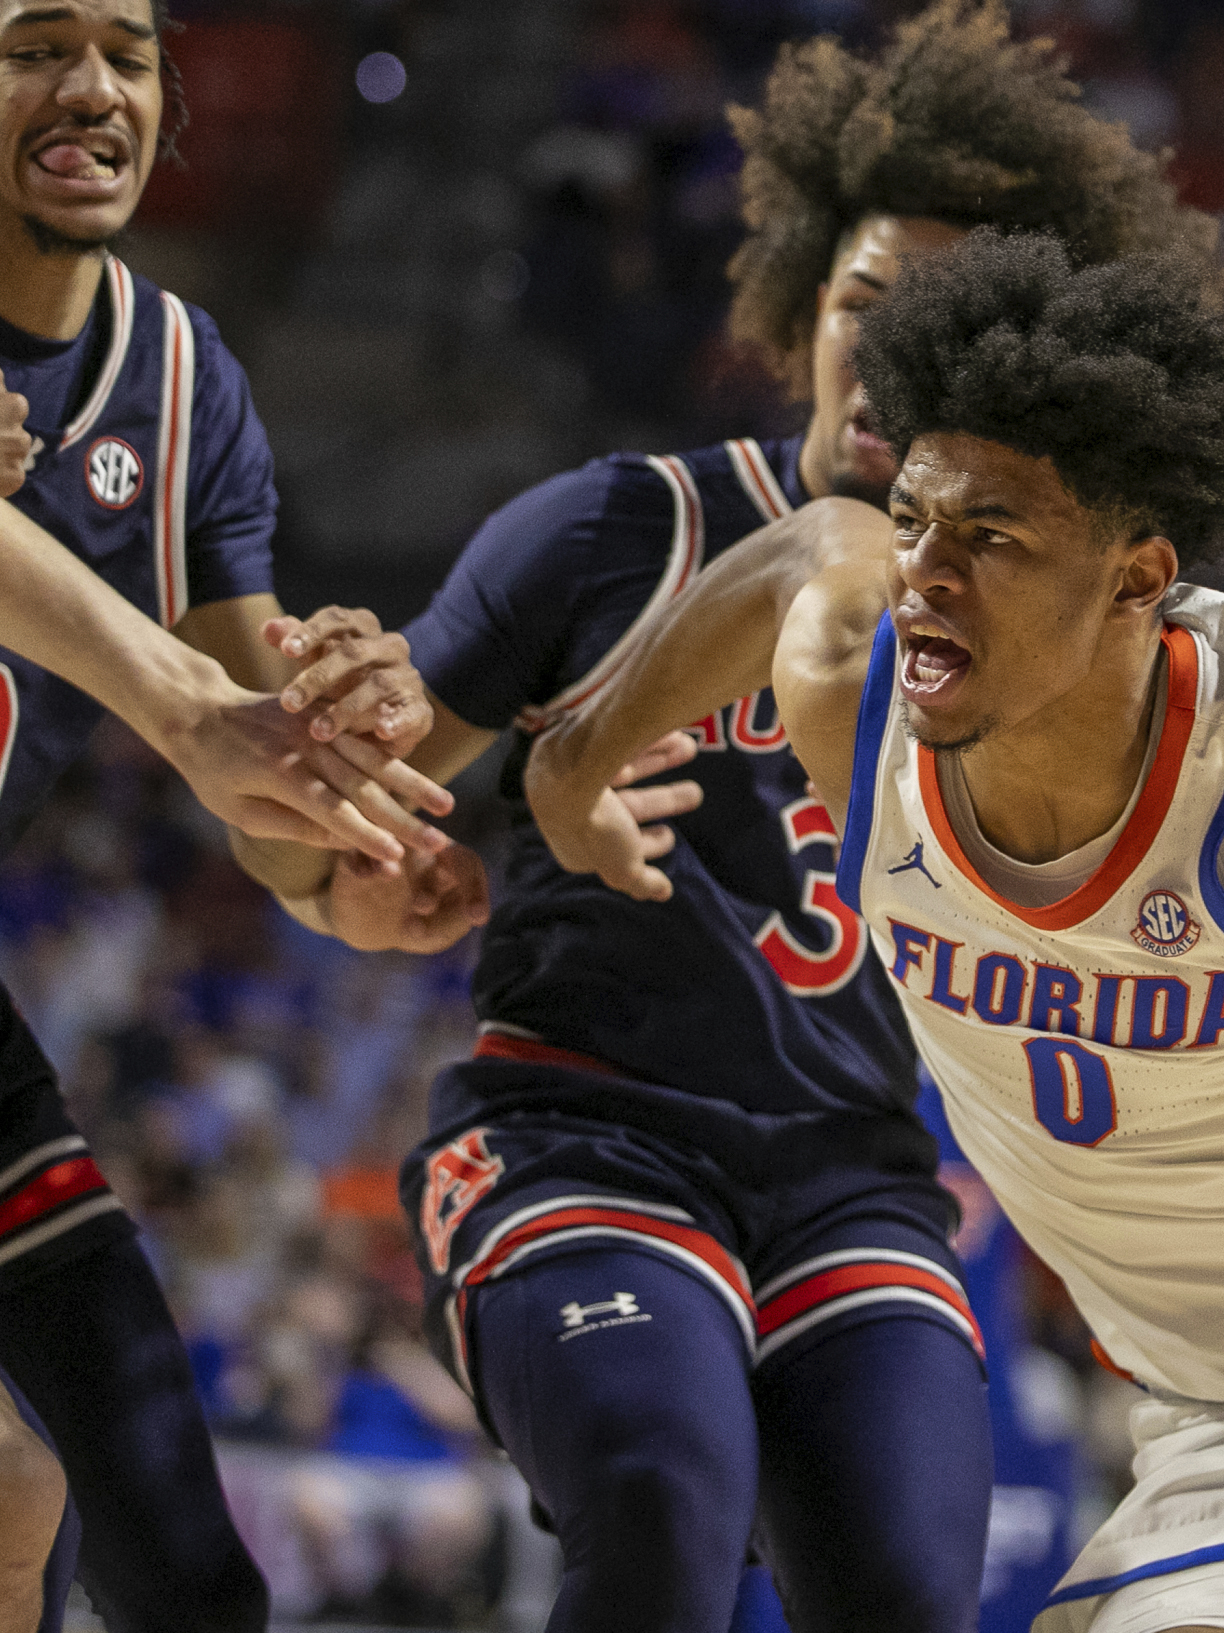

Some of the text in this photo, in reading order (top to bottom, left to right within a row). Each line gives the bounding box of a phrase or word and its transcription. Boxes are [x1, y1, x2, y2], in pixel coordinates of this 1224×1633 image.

[90, 441, 140, 504] SEC
[1142, 895, 1185, 940] SEC
[1141, 935, 1194, 956] GRADUATE
[1022, 1037, 1118, 1148] 0
